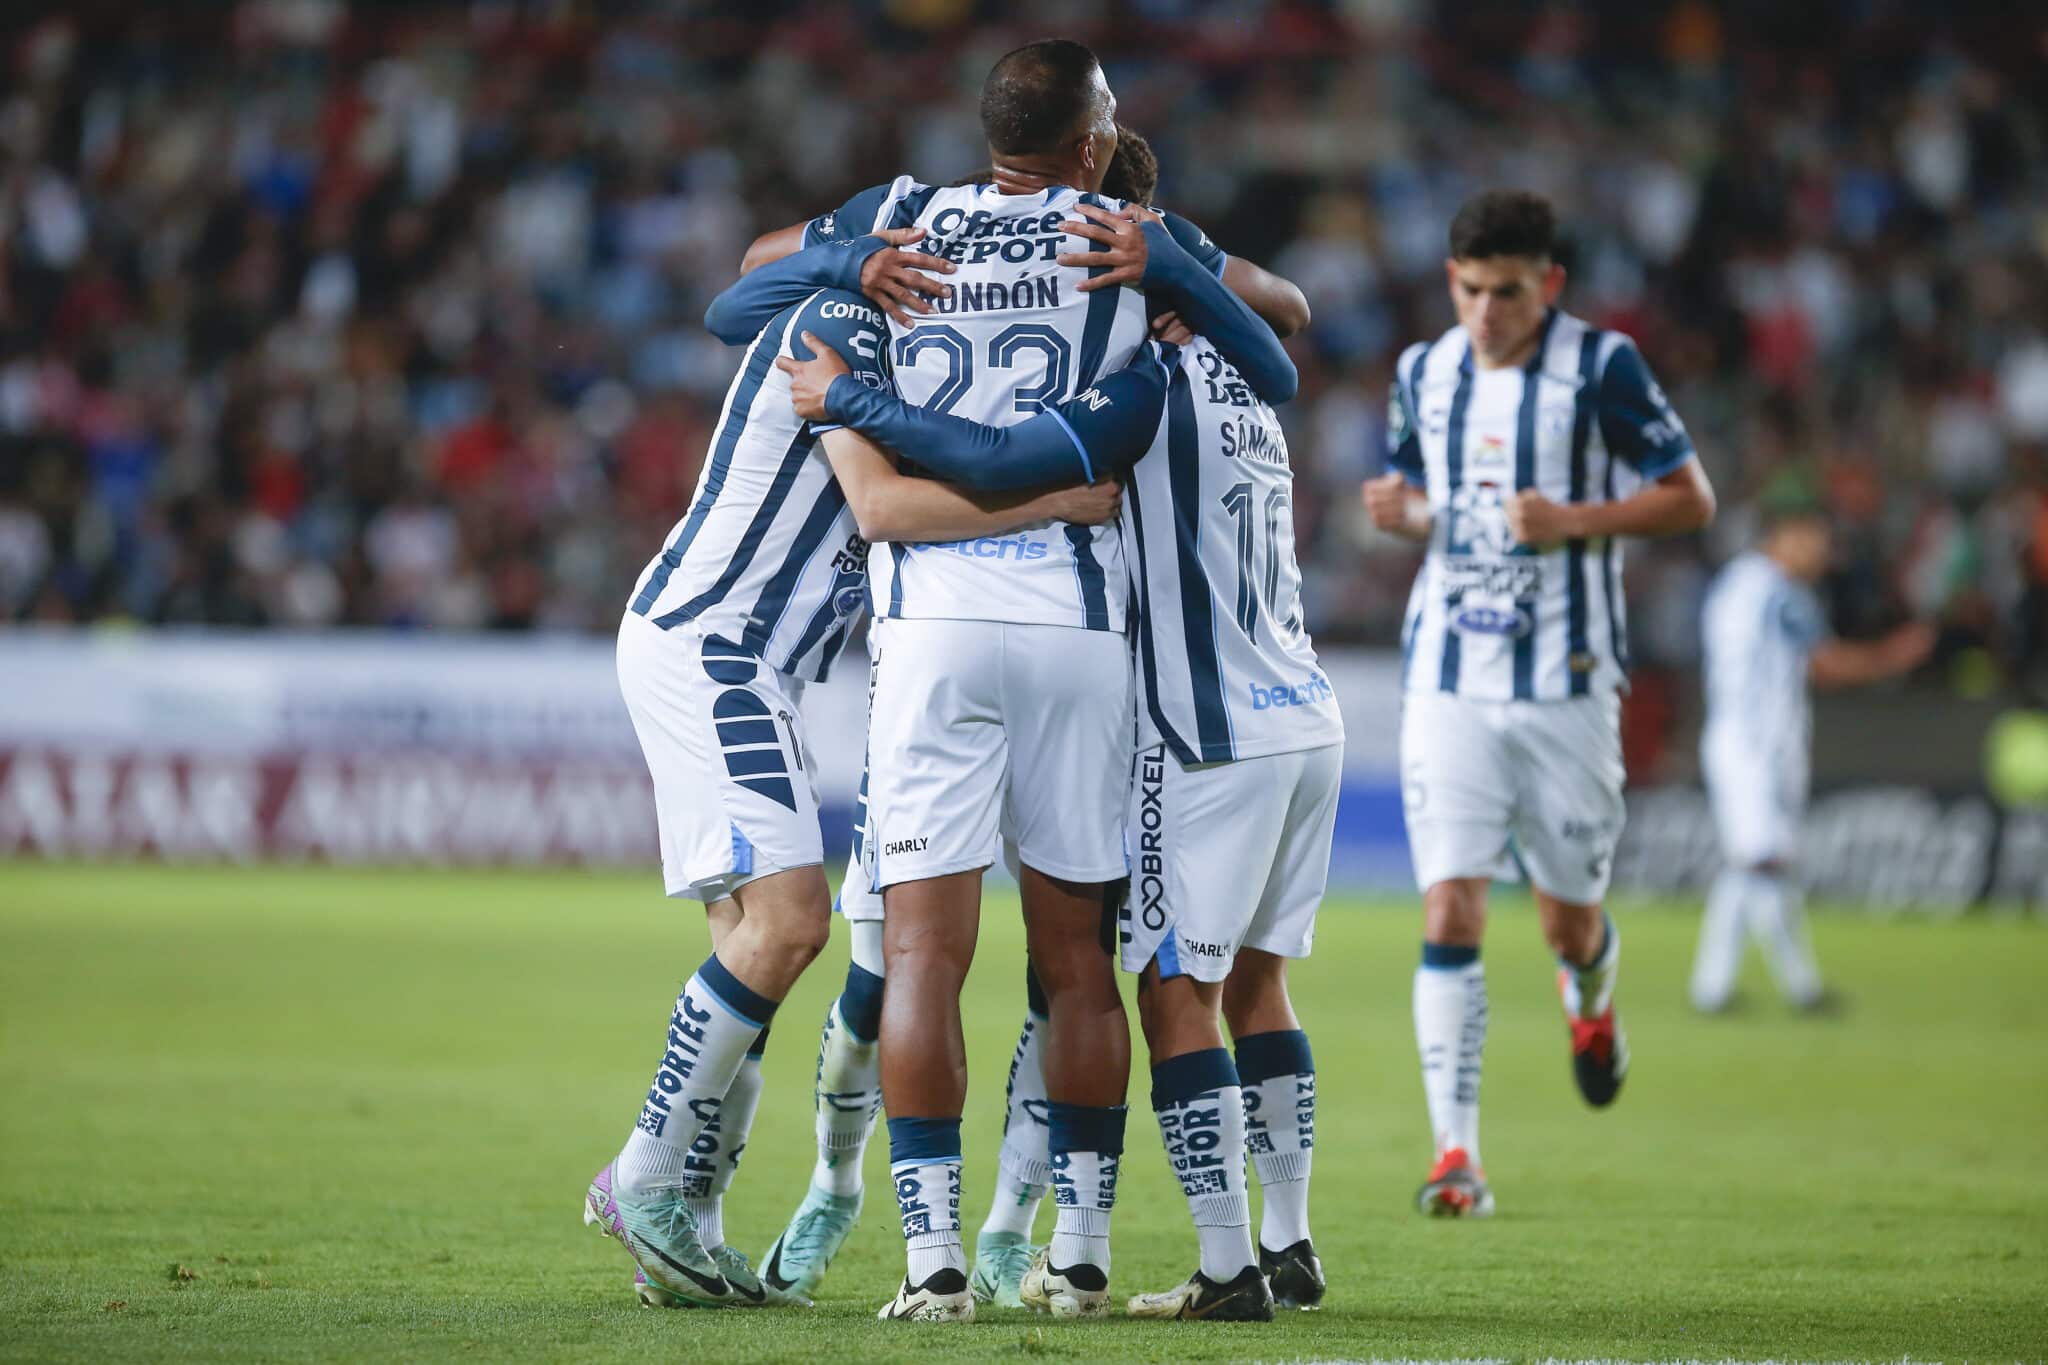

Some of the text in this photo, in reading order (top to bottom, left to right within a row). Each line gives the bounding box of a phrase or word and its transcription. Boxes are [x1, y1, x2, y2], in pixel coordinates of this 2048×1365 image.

[931, 207, 1066, 240] Office
[895, 323, 1072, 416] 23
[1220, 482, 1300, 646] 10
[885, 837, 929, 857] CHARLY
[1140, 744, 1166, 876] BROXEL
[650, 994, 712, 1114] FORTEC
